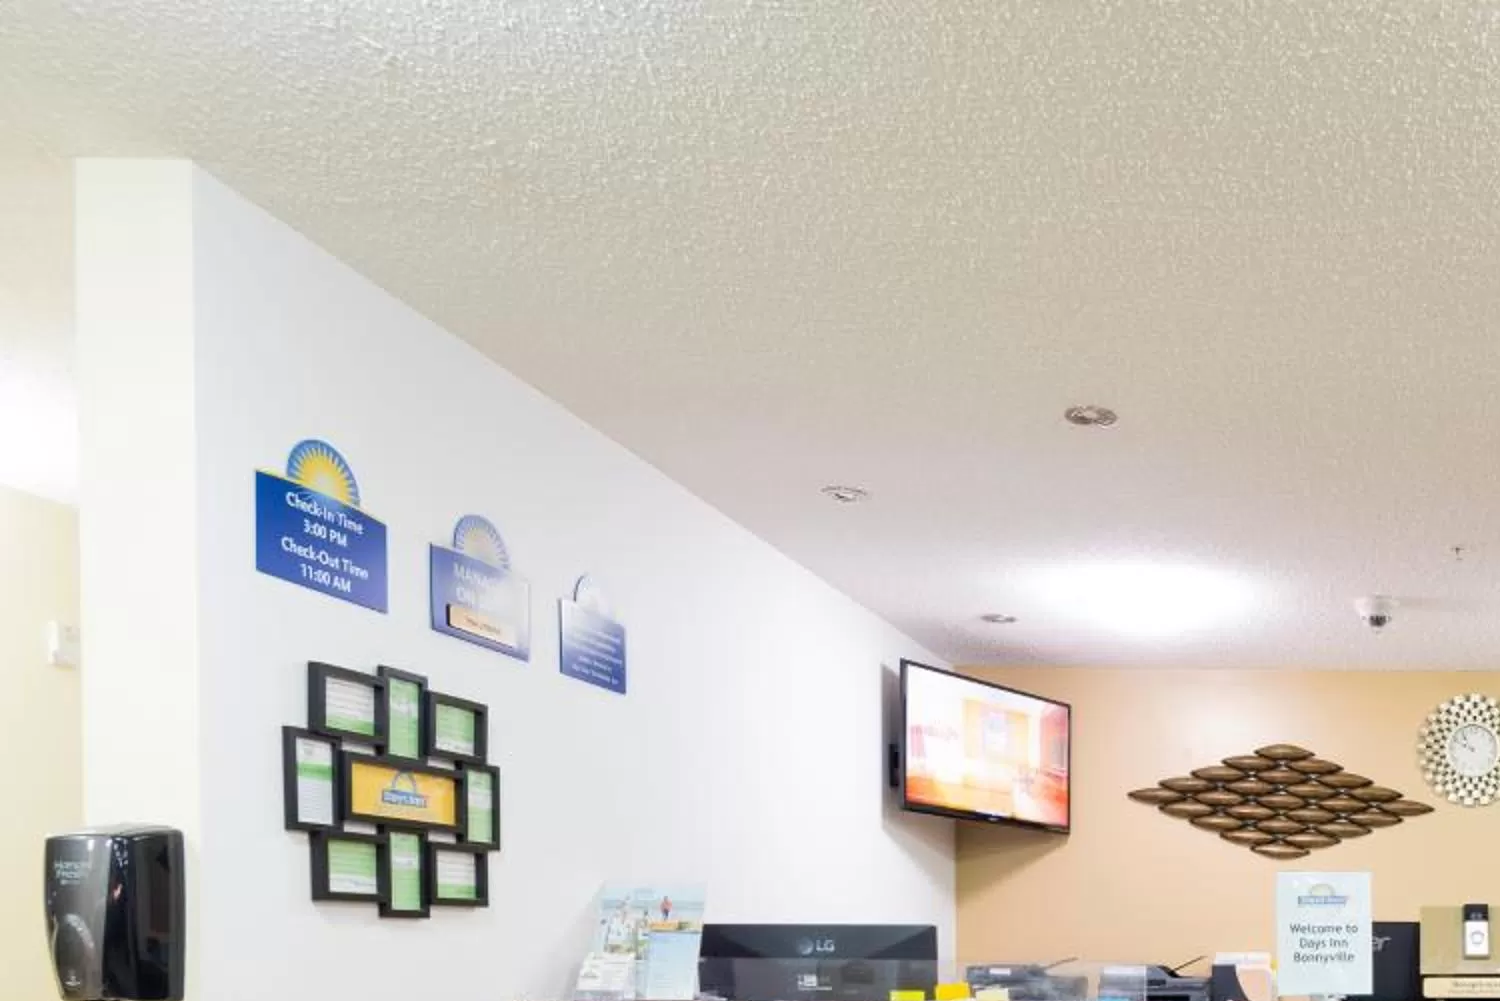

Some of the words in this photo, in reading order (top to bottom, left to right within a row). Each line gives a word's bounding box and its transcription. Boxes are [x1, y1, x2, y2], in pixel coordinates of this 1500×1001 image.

[336, 510, 365, 534] Time
[303, 519, 327, 540] 3:00
[329, 529, 348, 547] PM
[281, 536, 339, 569] Check-Out
[342, 558, 369, 580] Time
[300, 564, 331, 587] 11:00
[332, 576, 352, 593] AM
[1289, 923, 1342, 934] Welcome
[1345, 923, 1359, 934] to
[815, 939, 836, 952] LG
[1299, 937, 1327, 950] Days
[1329, 937, 1349, 948] Inn
[1293, 951, 1355, 964] Bonnyville
